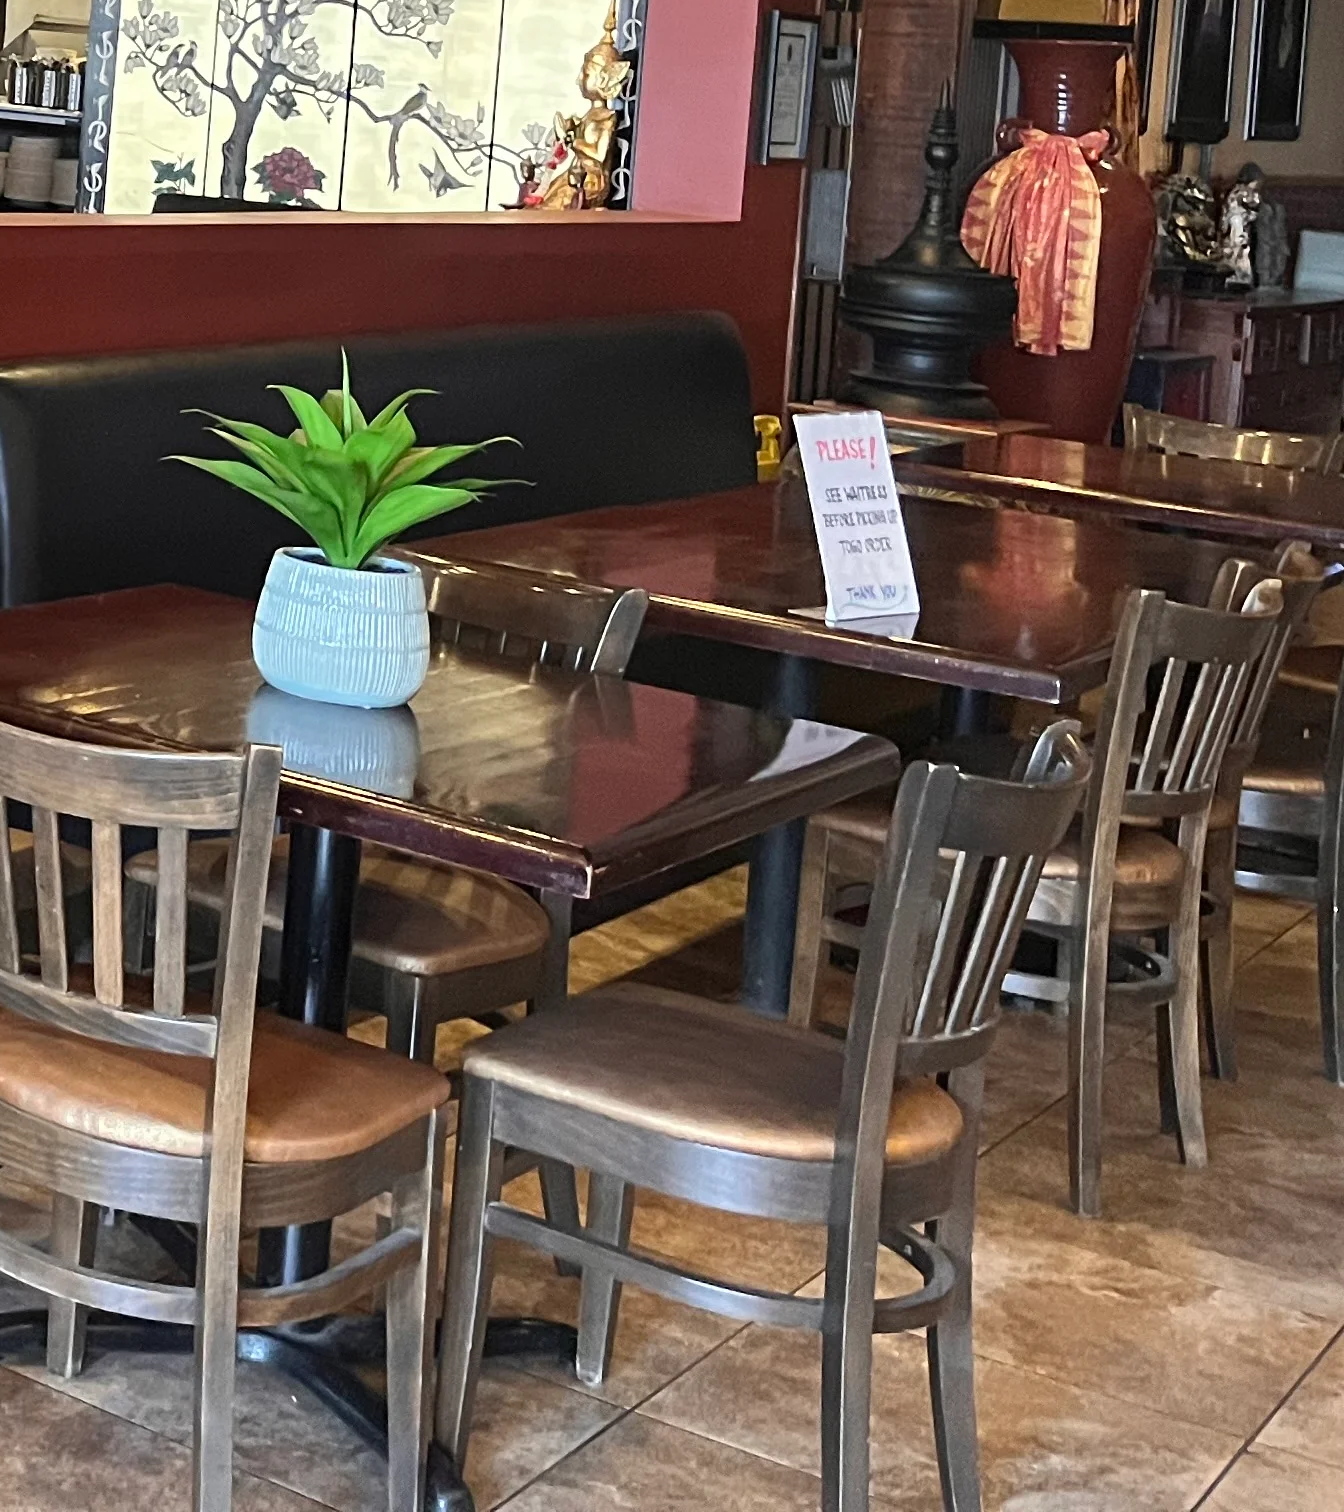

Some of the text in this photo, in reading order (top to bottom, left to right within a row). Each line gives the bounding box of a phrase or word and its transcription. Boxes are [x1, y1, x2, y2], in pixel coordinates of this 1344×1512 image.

[825, 487, 843, 503] SEE
[822, 512, 855, 527] BEFORE
[864, 537, 892, 553] ORDER
[846, 584, 896, 601] THANK YOU
